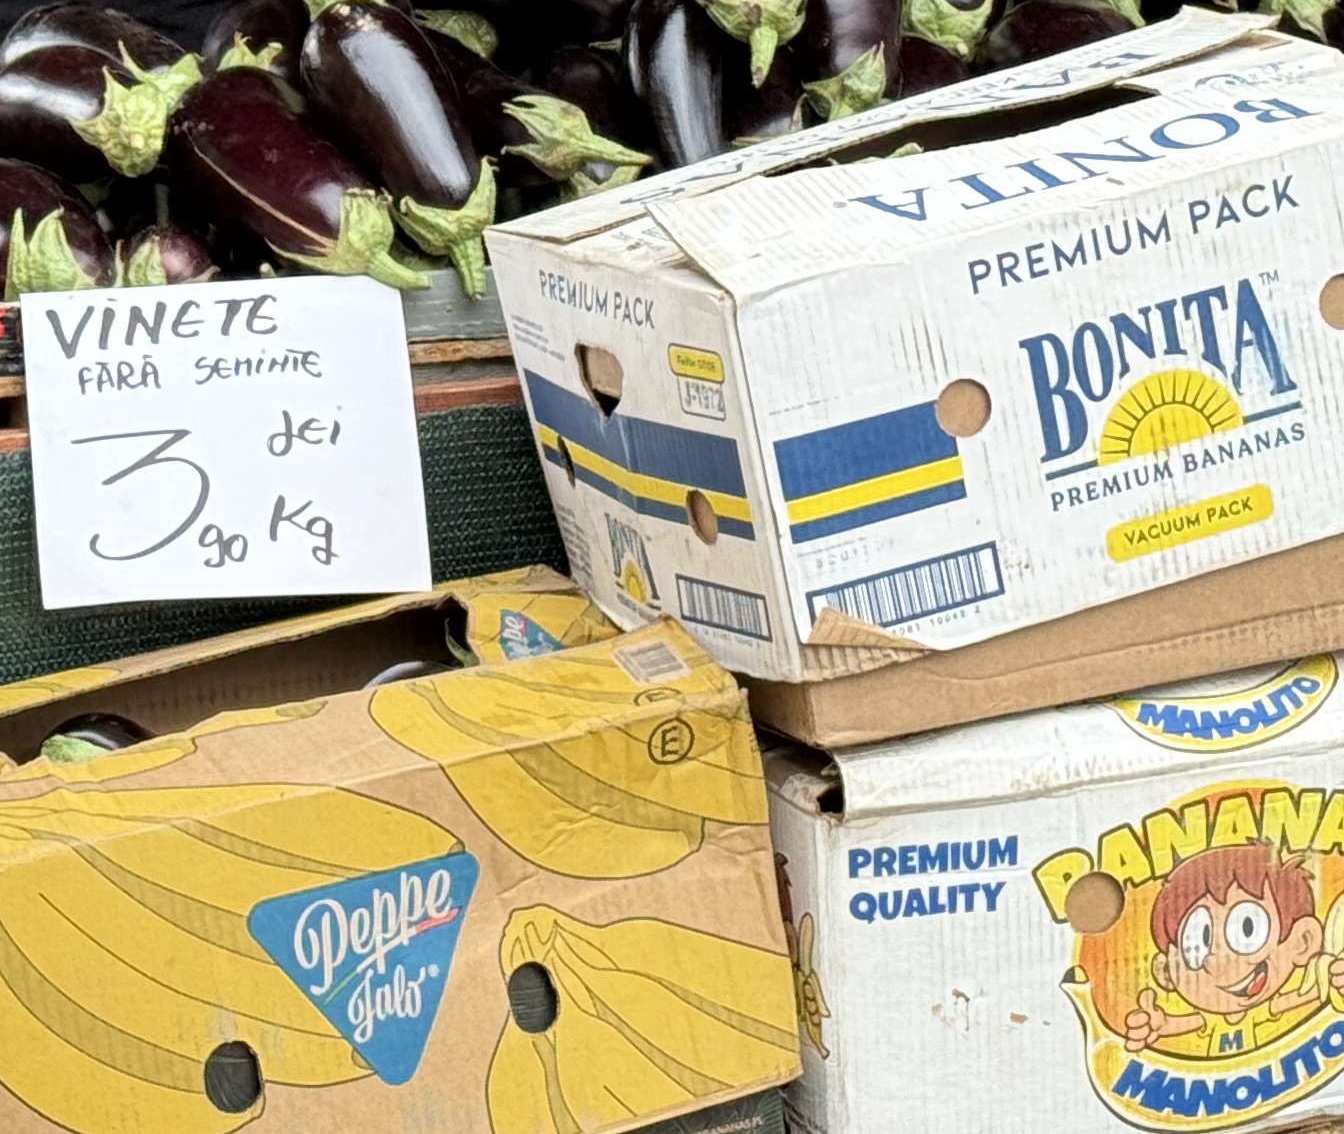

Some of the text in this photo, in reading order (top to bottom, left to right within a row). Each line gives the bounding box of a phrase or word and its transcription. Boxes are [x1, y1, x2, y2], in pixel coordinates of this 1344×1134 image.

[851, 97, 1325, 222] BONITA
[967, 174, 1301, 296] PREMIUM PACK
[538, 269, 656, 330] PREMIUM PACK
[1018, 277, 1298, 464] BONITA
[1050, 422, 1306, 513] PREMIUM BANANAS
[1123, 496, 1254, 546] VACUUM PACK
[1138, 672, 1323, 740] MANOLITO
[847, 834, 1019, 879] PREMIUM
[292, 866, 454, 1000] Peppe
[848, 881, 1008, 924] QUALITY
